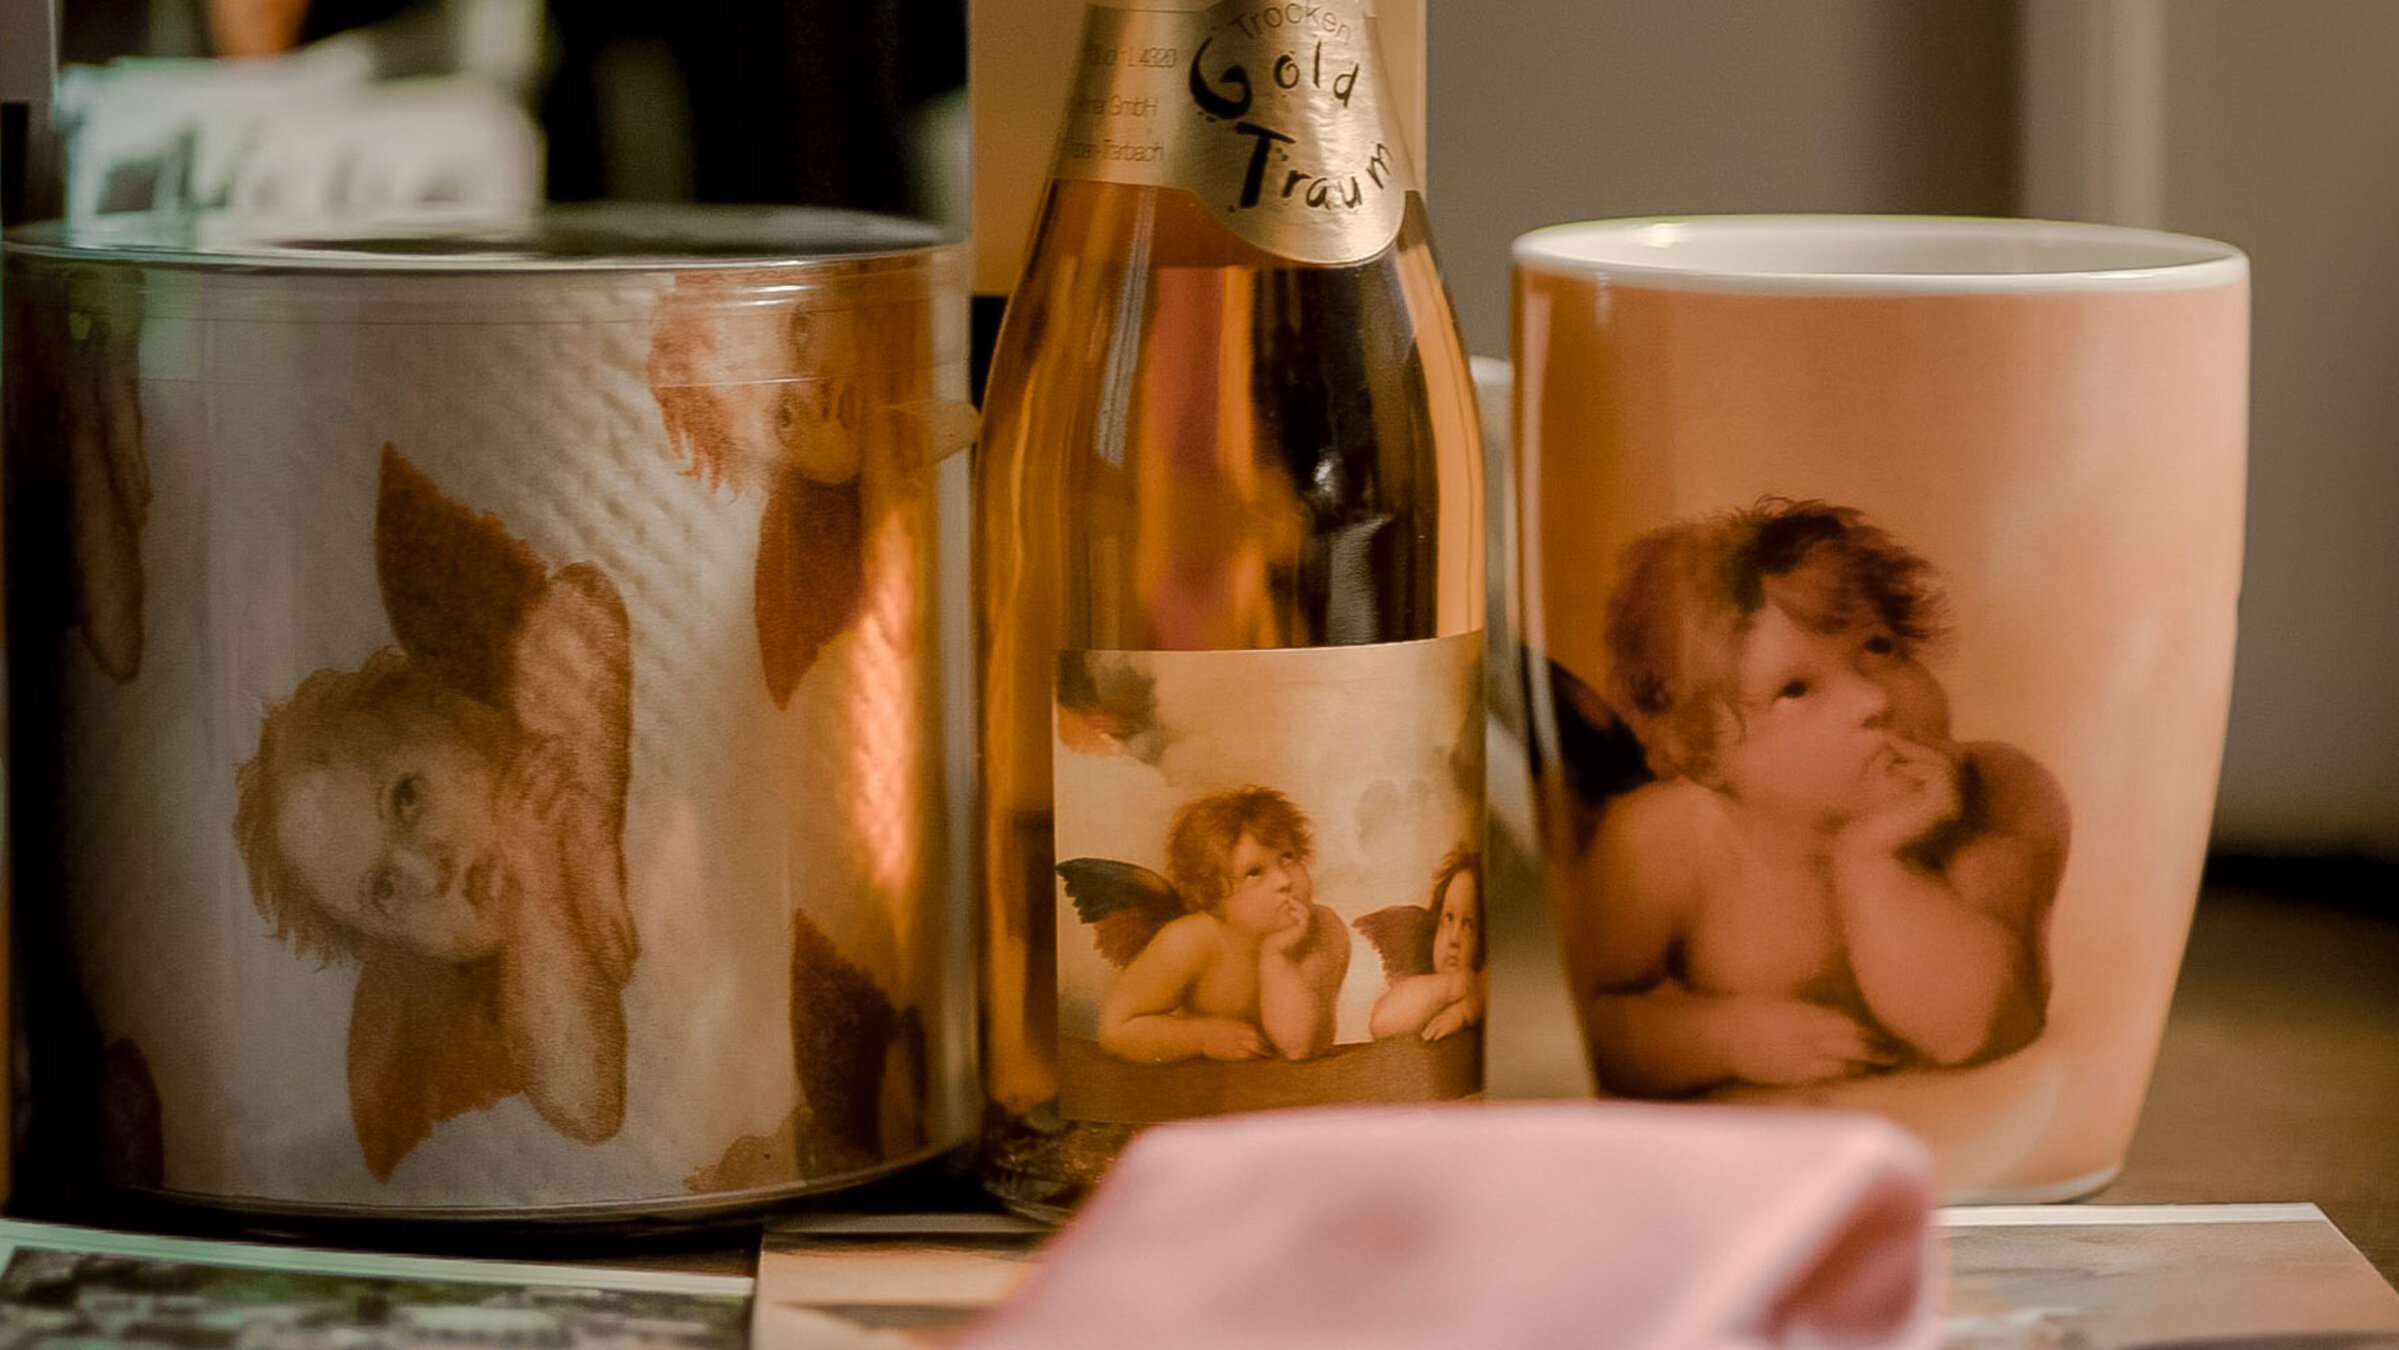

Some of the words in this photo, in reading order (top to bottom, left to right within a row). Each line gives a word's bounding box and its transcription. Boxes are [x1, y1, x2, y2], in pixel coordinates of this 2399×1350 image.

[1229, 2, 1351, 41] Trocken
[1108, 95, 1159, 117] GmbH
[1189, 37, 1359, 120] Gold
[1235, 121, 1393, 209] Traum
